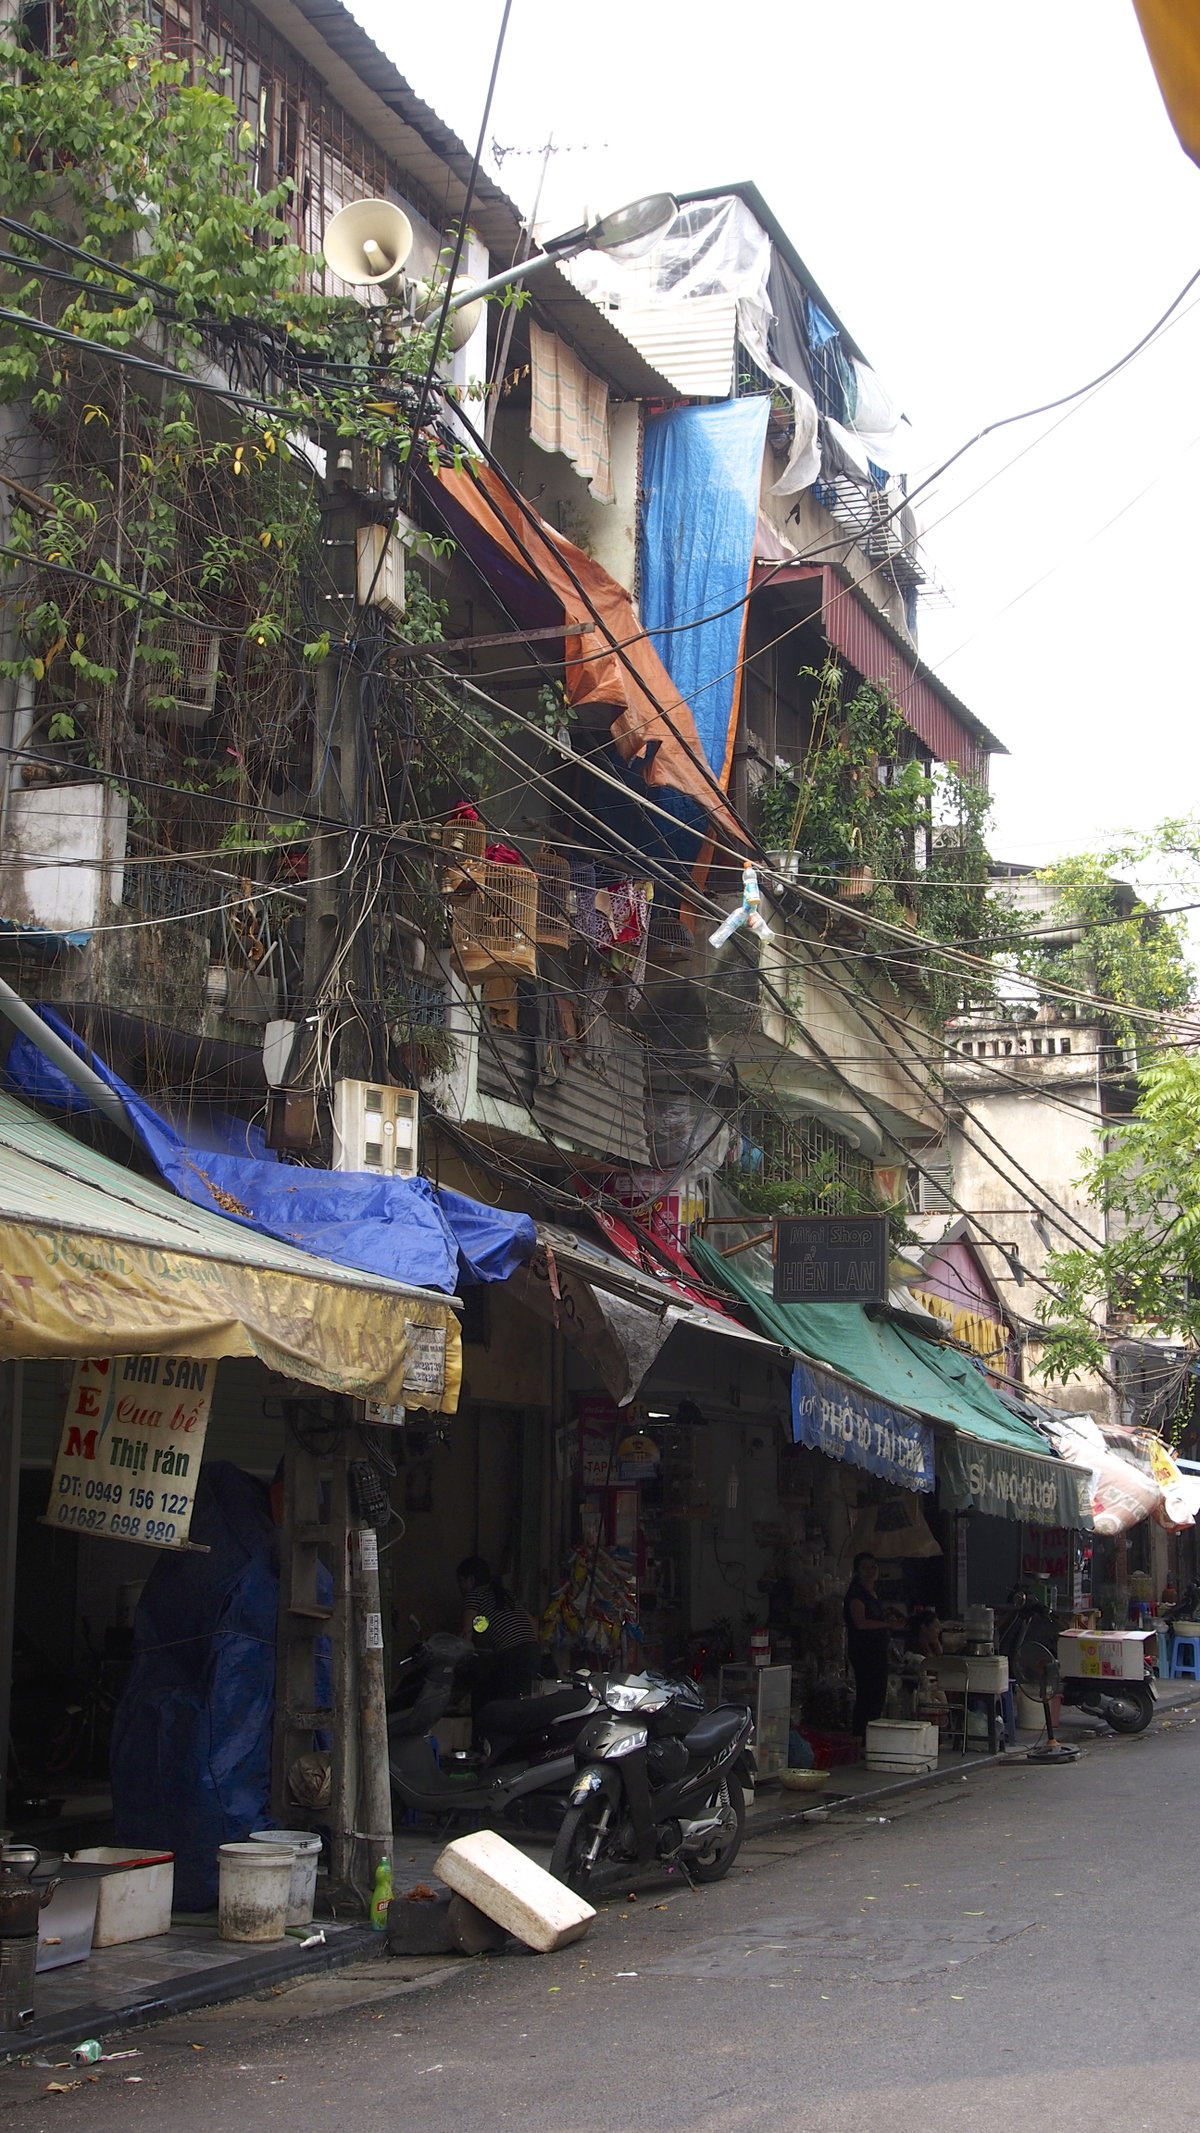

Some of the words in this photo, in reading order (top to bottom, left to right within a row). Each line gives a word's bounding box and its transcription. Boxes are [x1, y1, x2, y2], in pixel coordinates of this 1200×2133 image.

[790, 1226, 825, 1245] Mini
[830, 1225, 873, 1247] Shop
[833, 1260, 876, 1291] LAN
[115, 1395, 162, 1428] Cua
[109, 1436, 148, 1476] Thịt
[152, 1445, 190, 1478] rán
[85, 1479, 122, 1504] 0949
[128, 1487, 155, 1510] 156
[161, 1493, 188, 1516] 122
[57, 1503, 107, 1531] 01682
[110, 1513, 141, 1537] 698
[145, 1519, 176, 1543] 980
